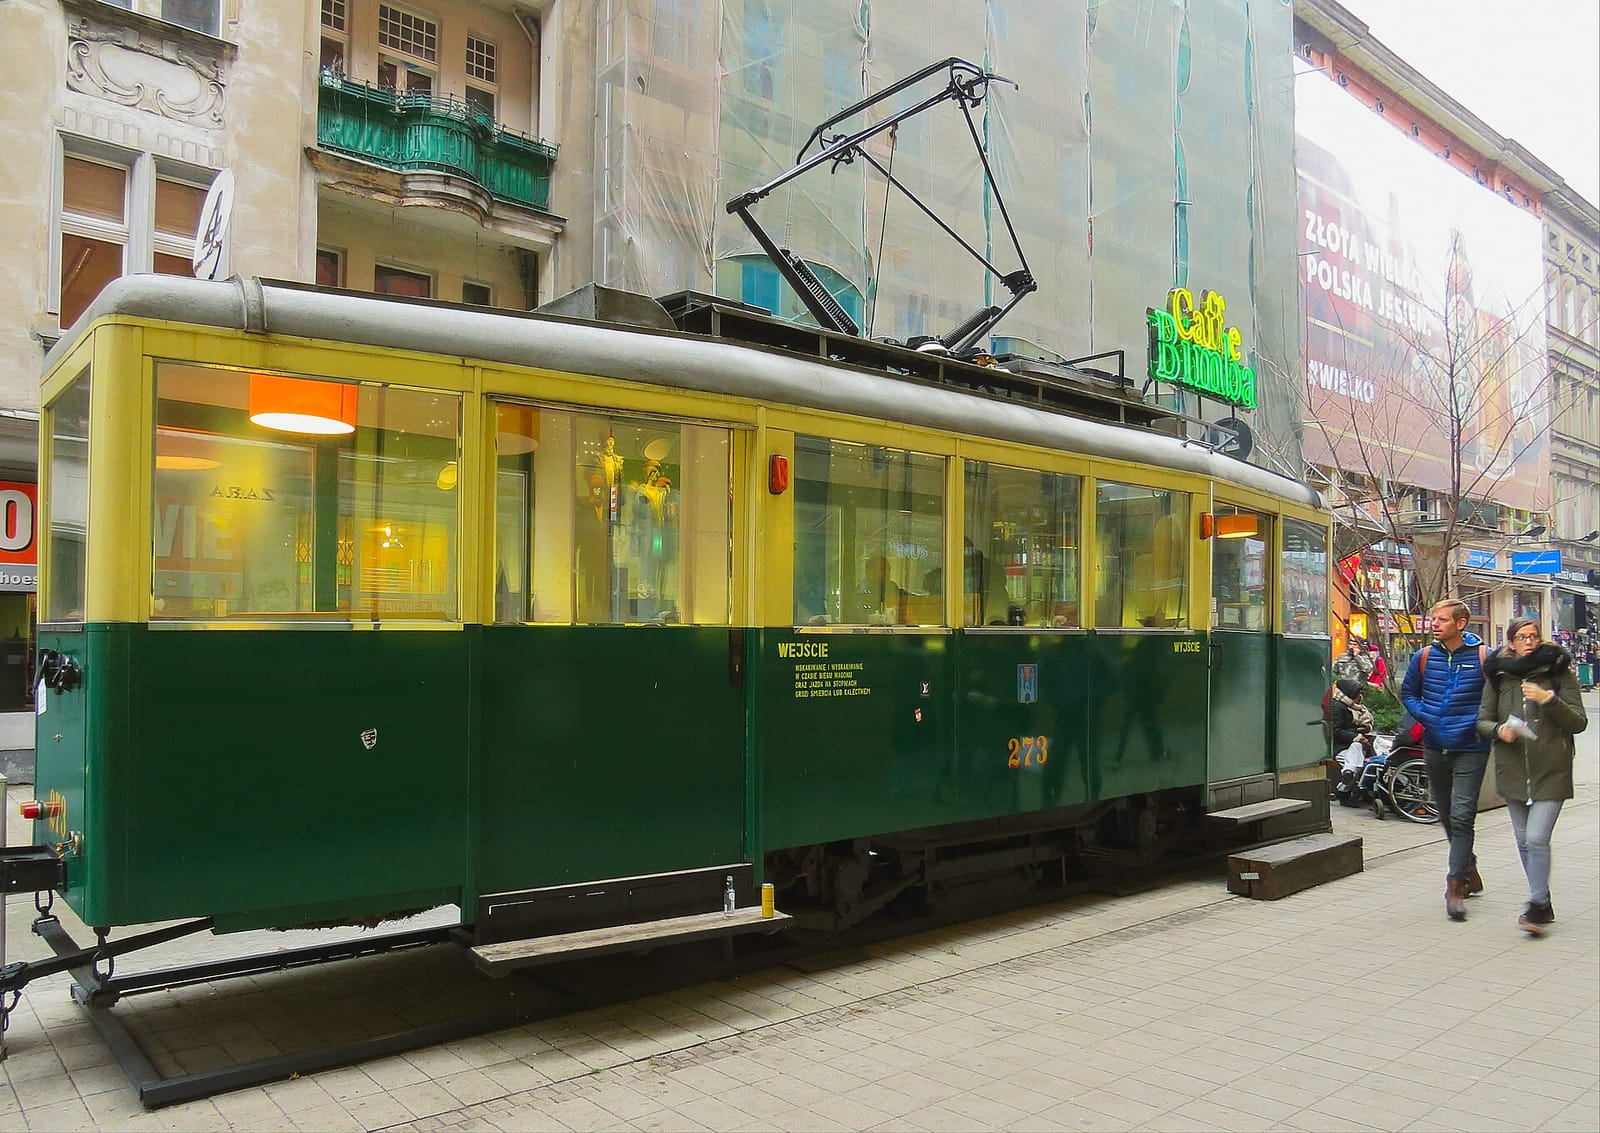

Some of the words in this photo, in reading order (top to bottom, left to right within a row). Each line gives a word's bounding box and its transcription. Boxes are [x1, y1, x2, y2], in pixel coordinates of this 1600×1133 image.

[1304, 209, 1360, 264] ZŁOTA
[1305, 255, 1373, 312] POLSKA
[1149, 309, 1257, 409] Bimba
[777, 639, 829, 658] WEJŚCIE
[1007, 735, 1049, 769] 273
